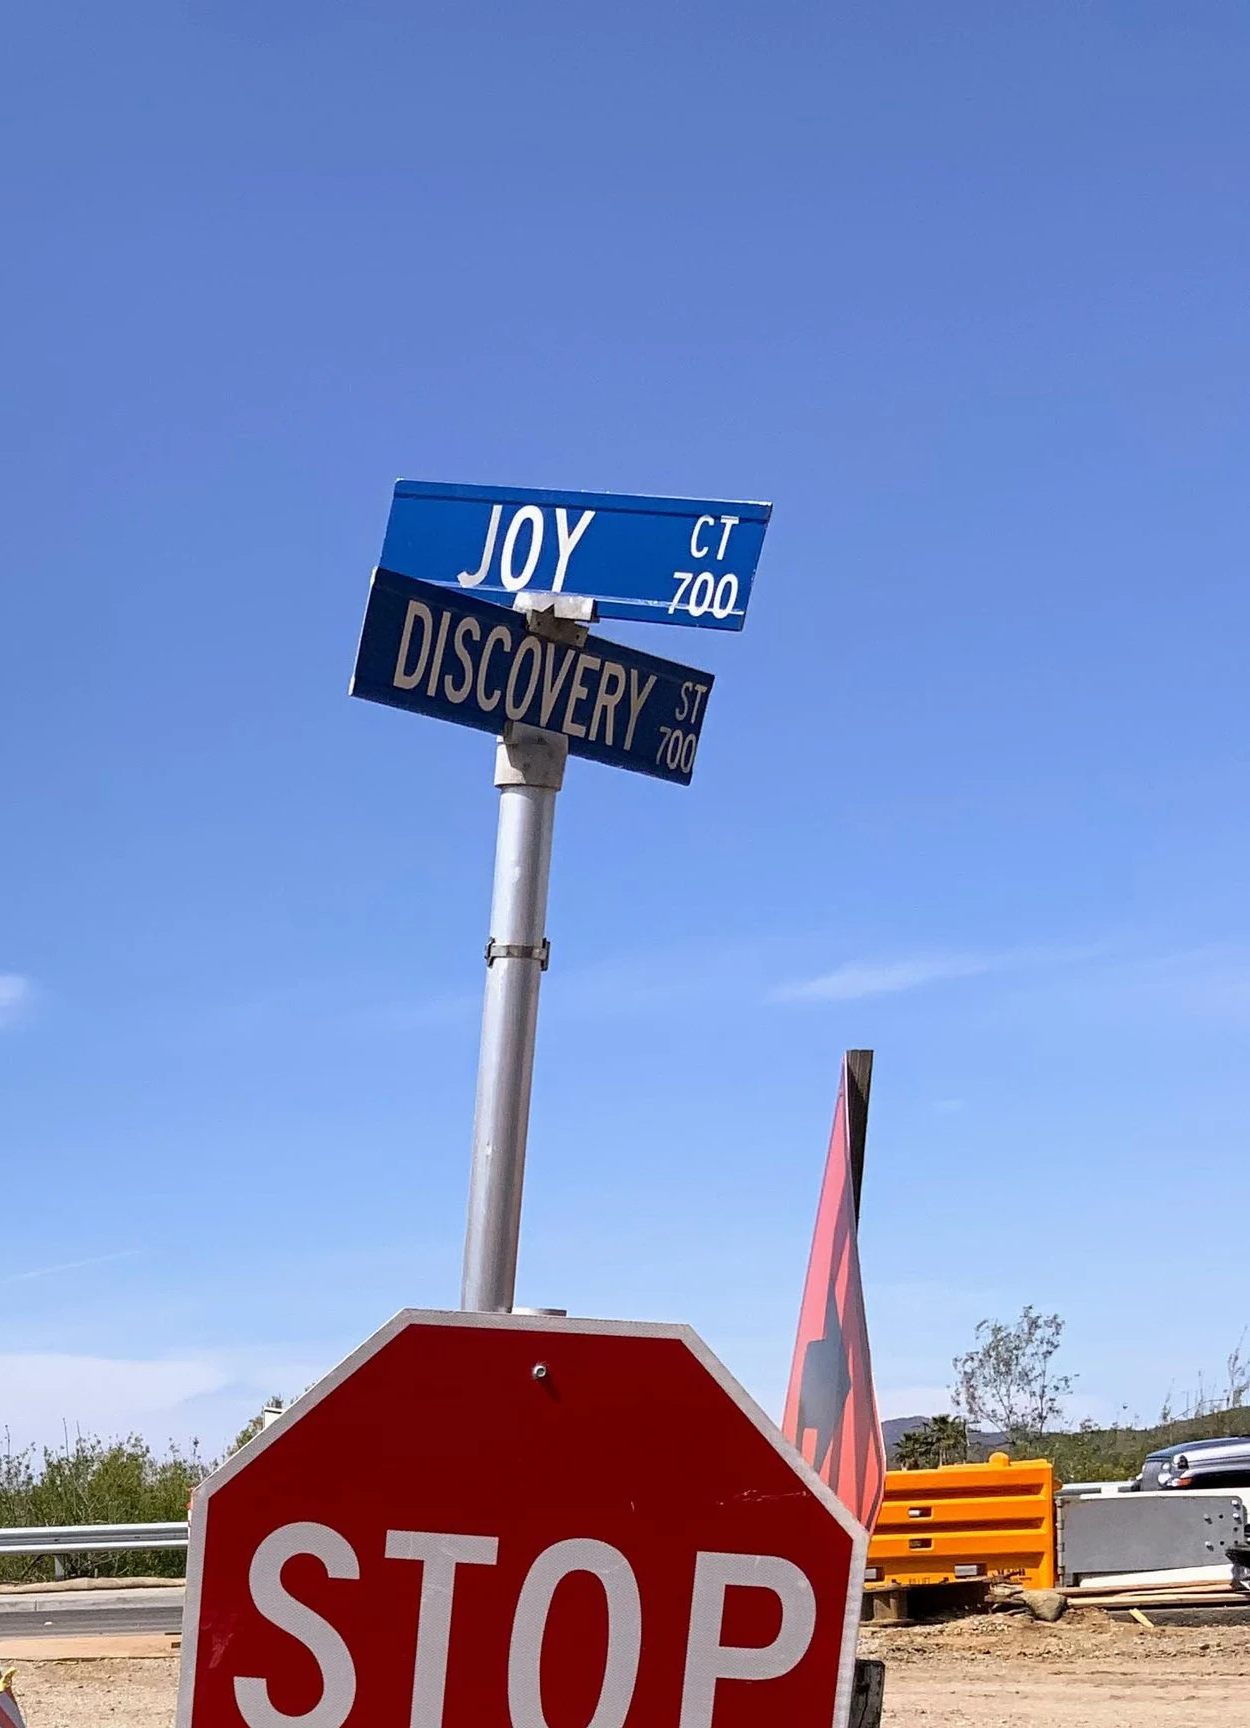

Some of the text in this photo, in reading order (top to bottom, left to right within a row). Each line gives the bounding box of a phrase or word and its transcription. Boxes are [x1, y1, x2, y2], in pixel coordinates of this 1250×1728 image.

[456, 504, 740, 593] JOY CT
[667, 571, 740, 619] 700
[392, 599, 707, 752] DISCOVERY ST
[655, 728, 698, 774] 700
